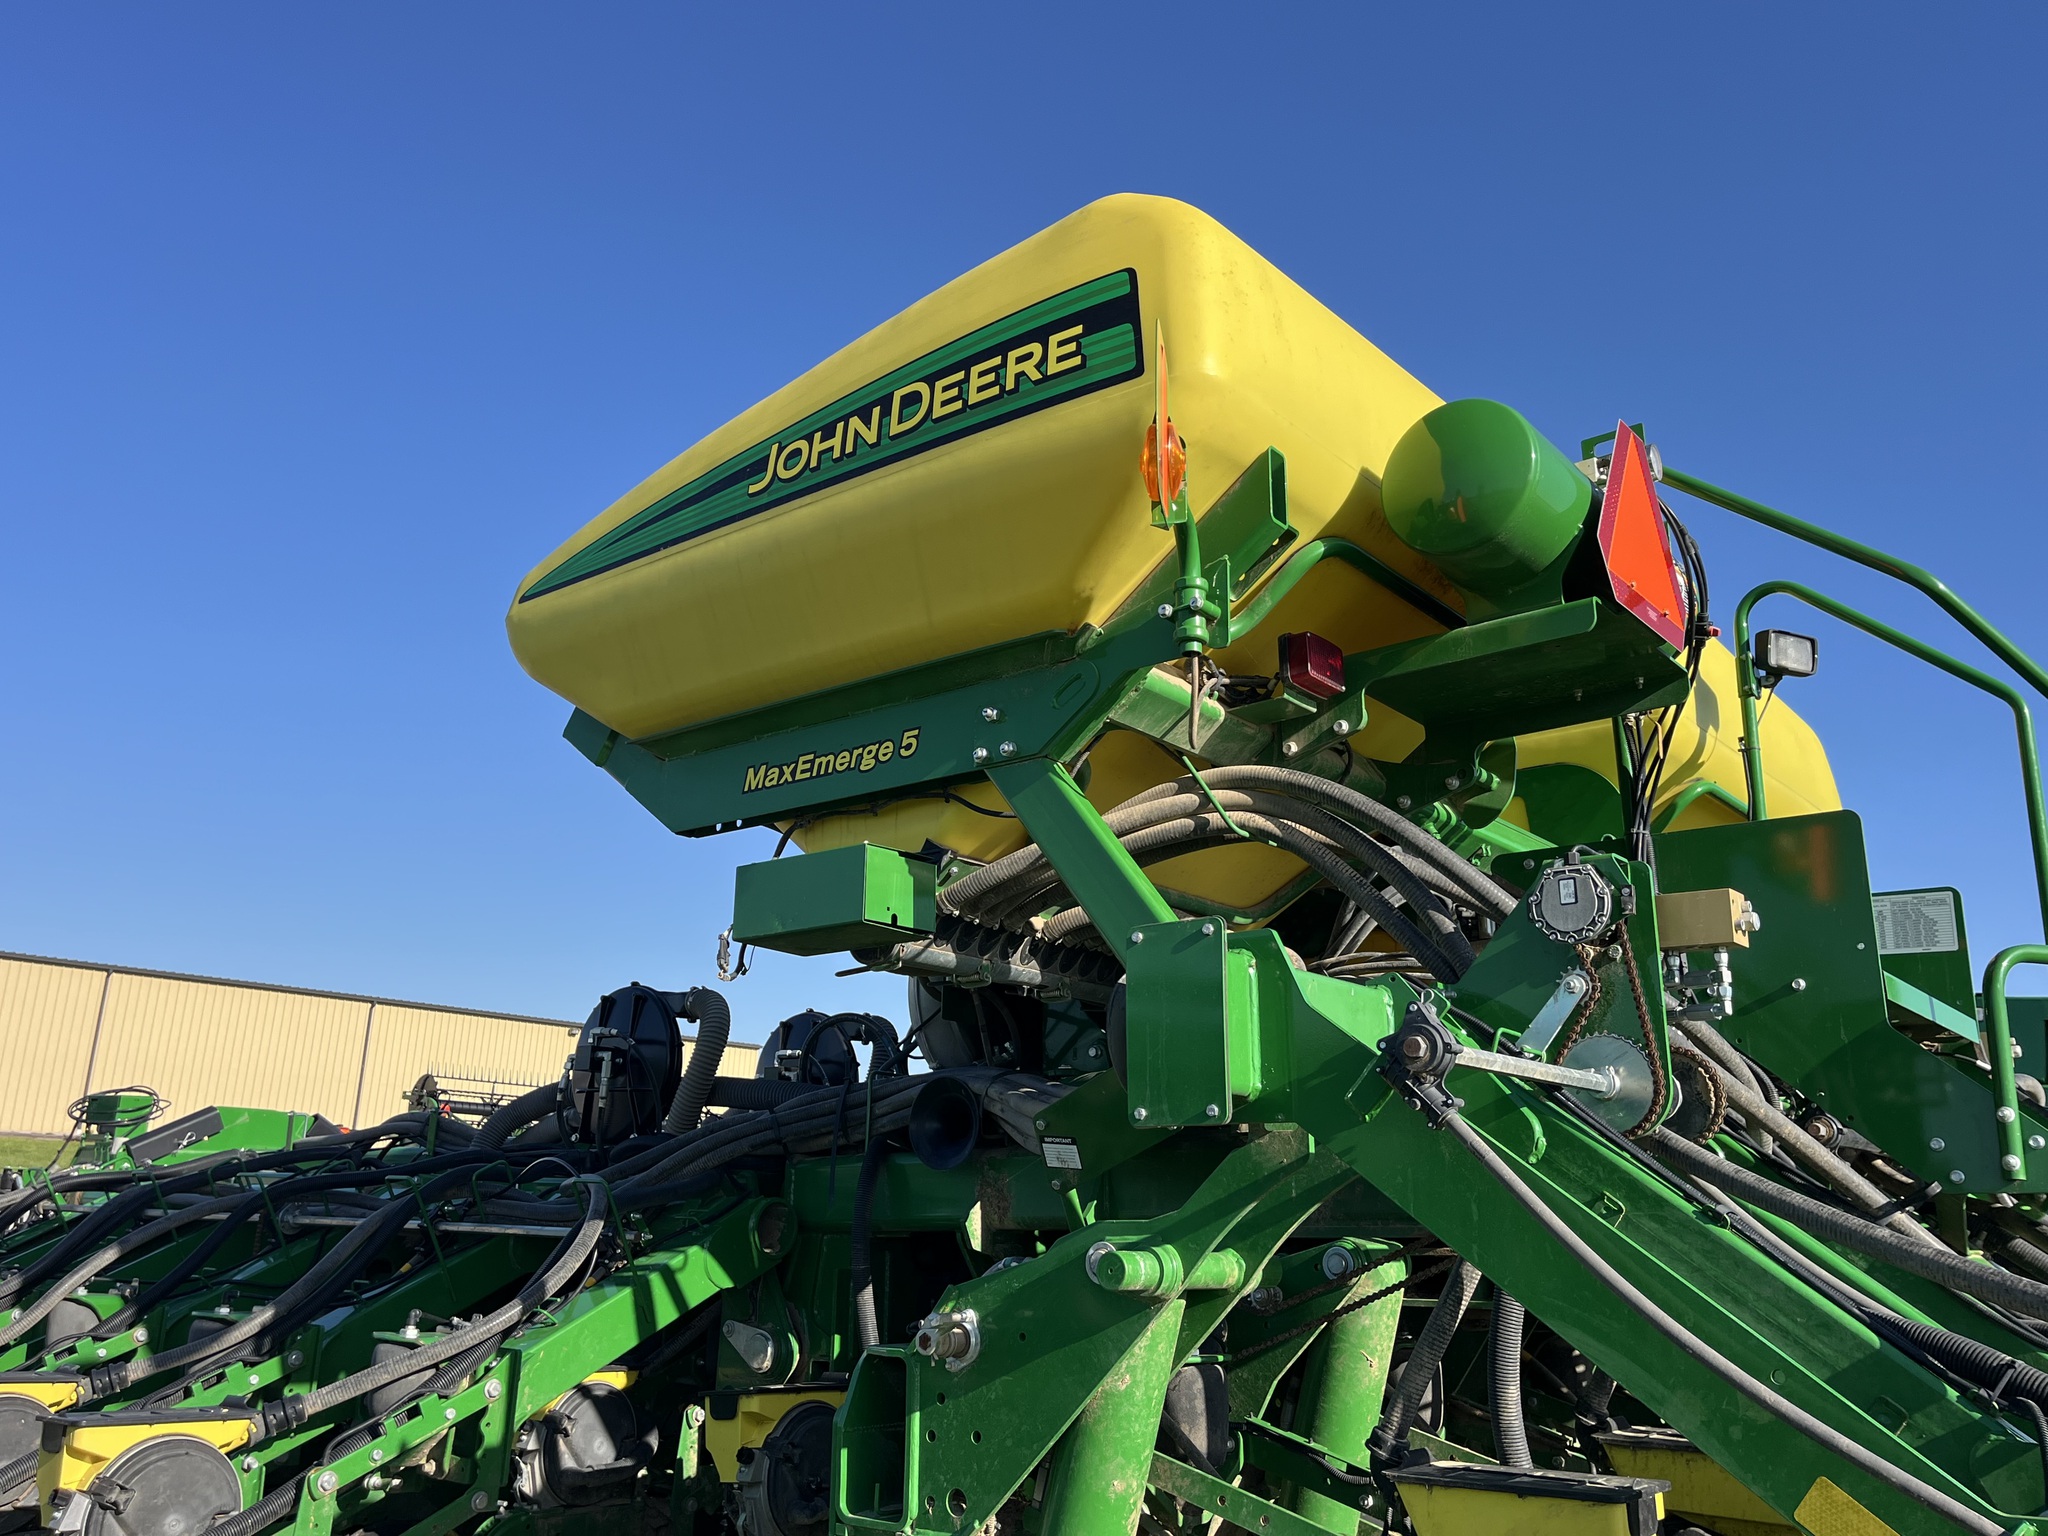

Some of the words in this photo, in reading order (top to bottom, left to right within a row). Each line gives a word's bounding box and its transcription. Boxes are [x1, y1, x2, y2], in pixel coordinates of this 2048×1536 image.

[747, 405, 881, 495] JOHN
[889, 324, 1084, 437] DEERE
[743, 739, 894, 792] MaxEmerge
[900, 728, 919, 757] 5
